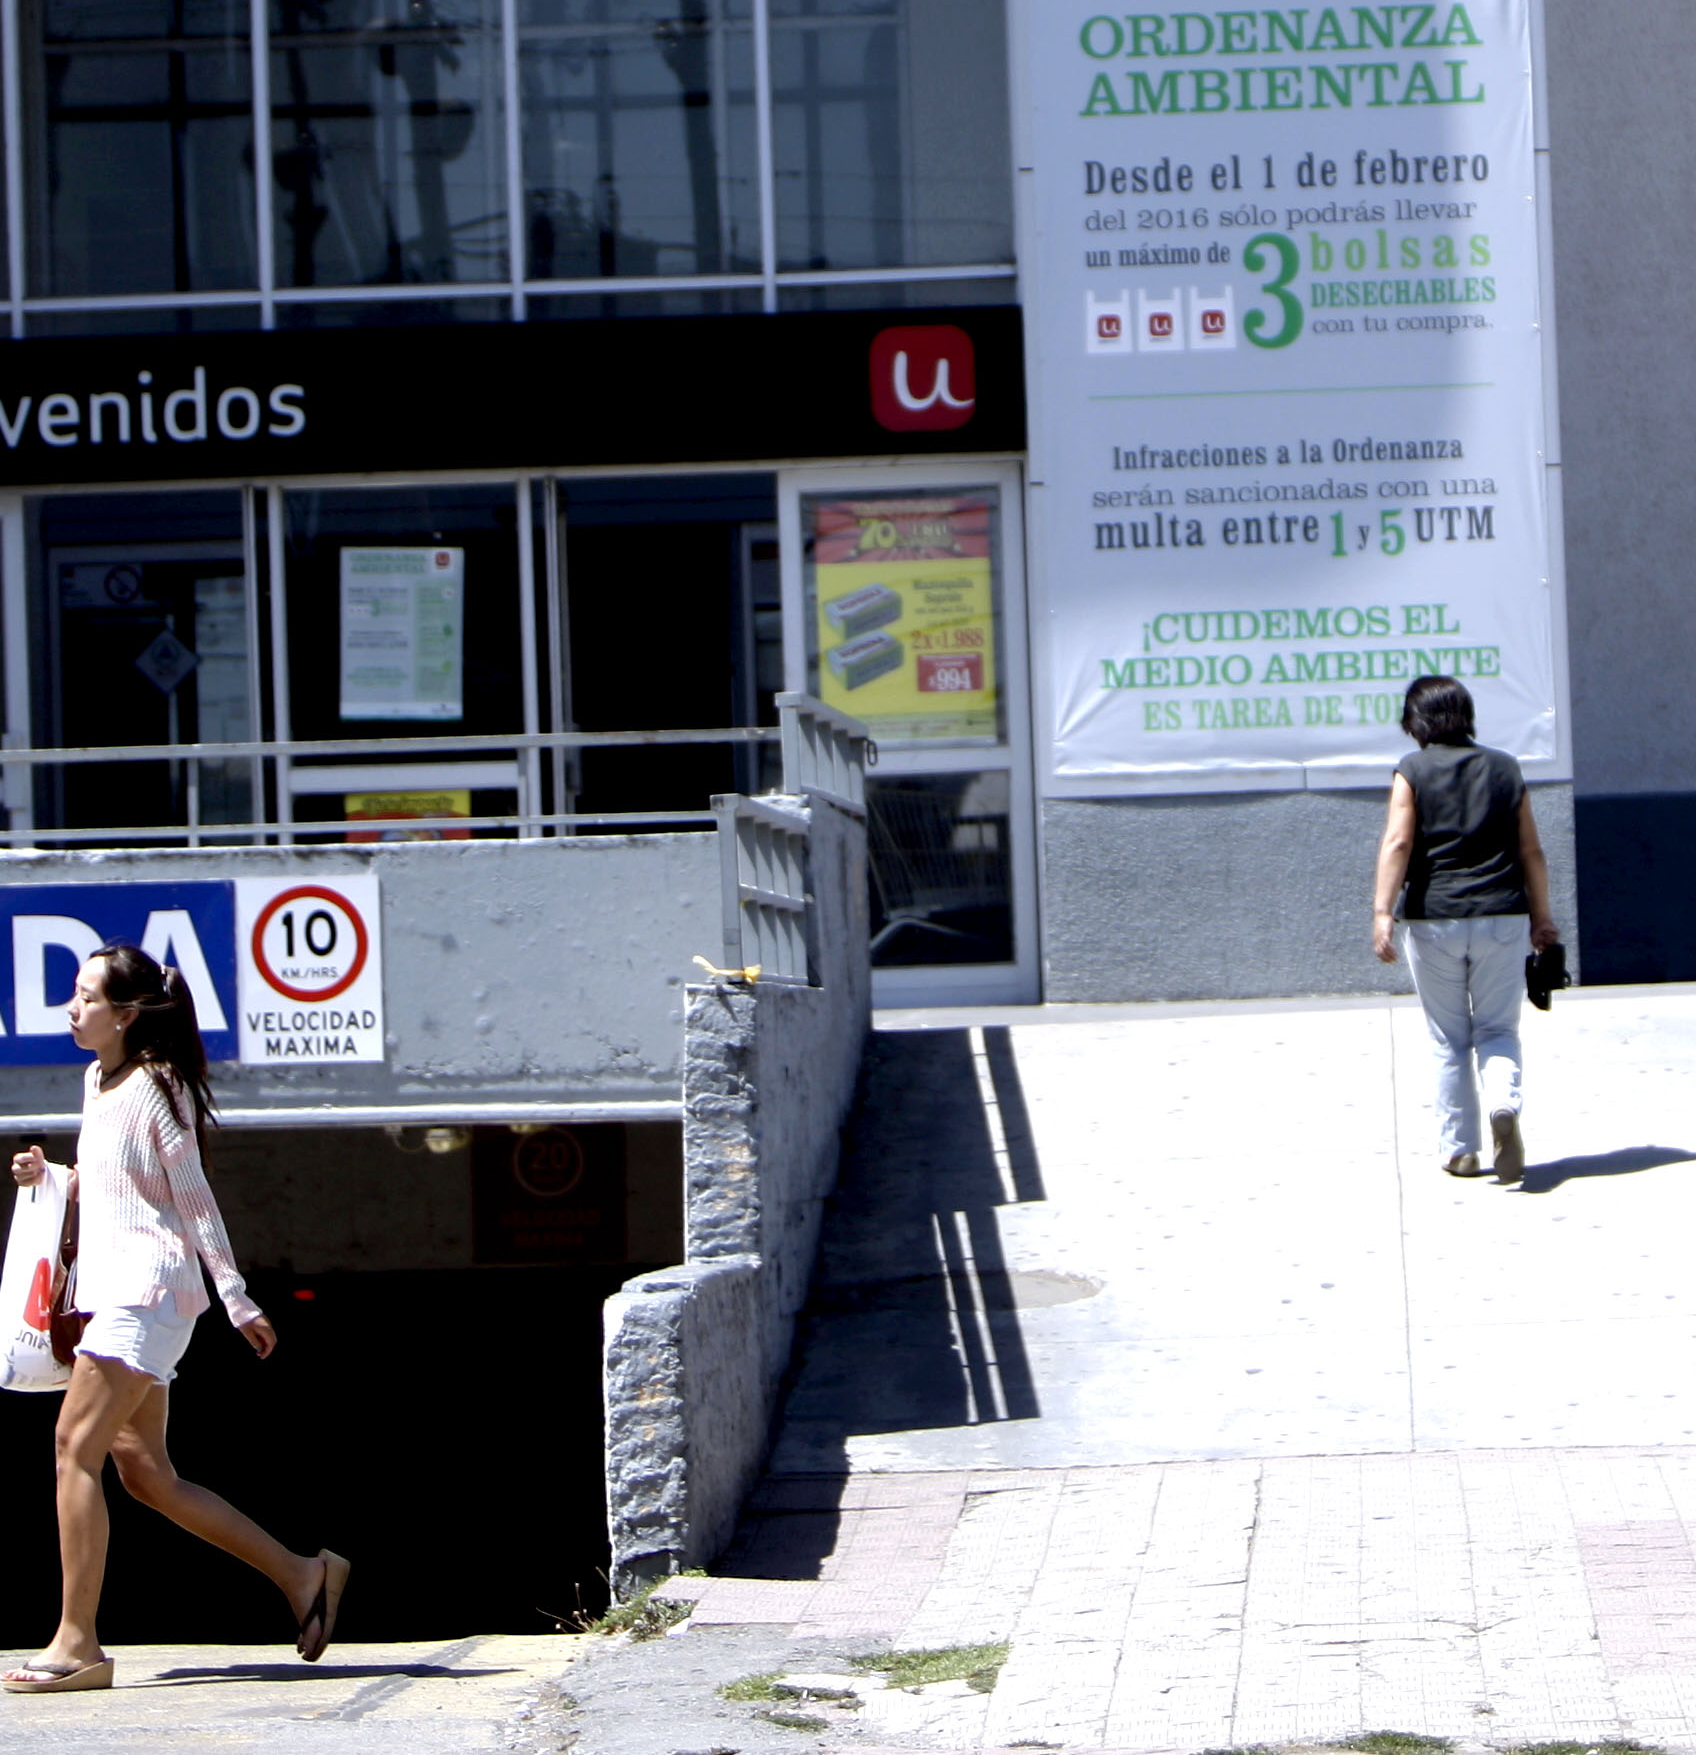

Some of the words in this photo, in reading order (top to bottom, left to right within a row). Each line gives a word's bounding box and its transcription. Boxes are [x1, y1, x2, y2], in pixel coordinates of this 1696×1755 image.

[1079, 3, 1483, 60] ORDENANZA
[1079, 60, 1485, 117] AMBIENTAL
[1085, 157, 1193, 195] Desde
[1211, 155, 1242, 191] el
[1262, 156, 1276, 189] 1
[1297, 153, 1337, 187] de
[1354, 149, 1489, 186] febrero
[1085, 208, 1126, 232] del
[1138, 208, 1209, 230] 2016
[1219, 201, 1277, 227] sólo
[1287, 199, 1386, 231] podrás
[1395, 197, 1477, 222] llevar
[1086, 250, 1111, 267] un
[1118, 242, 1201, 266] máximo
[1207, 241, 1231, 264] de
[1311, 229, 1491, 272] bolsas
[1243, 232, 1301, 349] 3
[1311, 277, 1496, 308] DESECHABLES
[1313, 317, 1354, 333] con
[1362, 313, 1387, 332] tu
[1113, 443, 1267, 471] Infracciones
[1278, 450, 1290, 465] a
[1300, 439, 1323, 465] la
[1333, 436, 1463, 463] Ordenanza
[1093, 484, 1174, 508] serán
[1185, 479, 1368, 505] sancionadas
[1379, 478, 1429, 498] con
[1440, 476, 1498, 495] una
[1094, 512, 1204, 551] multa
[1223, 513, 1320, 545] entre
[1331, 511, 1348, 557] 1
[1357, 525, 1370, 551] y
[1380, 508, 1405, 556] 5
[1413, 506, 1495, 542] UTM
[1142, 607, 1391, 652] ¡CUIDEMOS
[1401, 604, 1460, 635] EL
[1100, 655, 1253, 689] MEDIO
[1260, 647, 1501, 685] AMBIENTE
[1143, 700, 1182, 731] ES
[1192, 698, 1293, 730] TAREA
[1304, 694, 1343, 726] DE
[282, 909, 337, 957] 10
[248, 1010, 376, 1032] VELOCIDAD
[266, 1036, 358, 1056] MAXIMA
